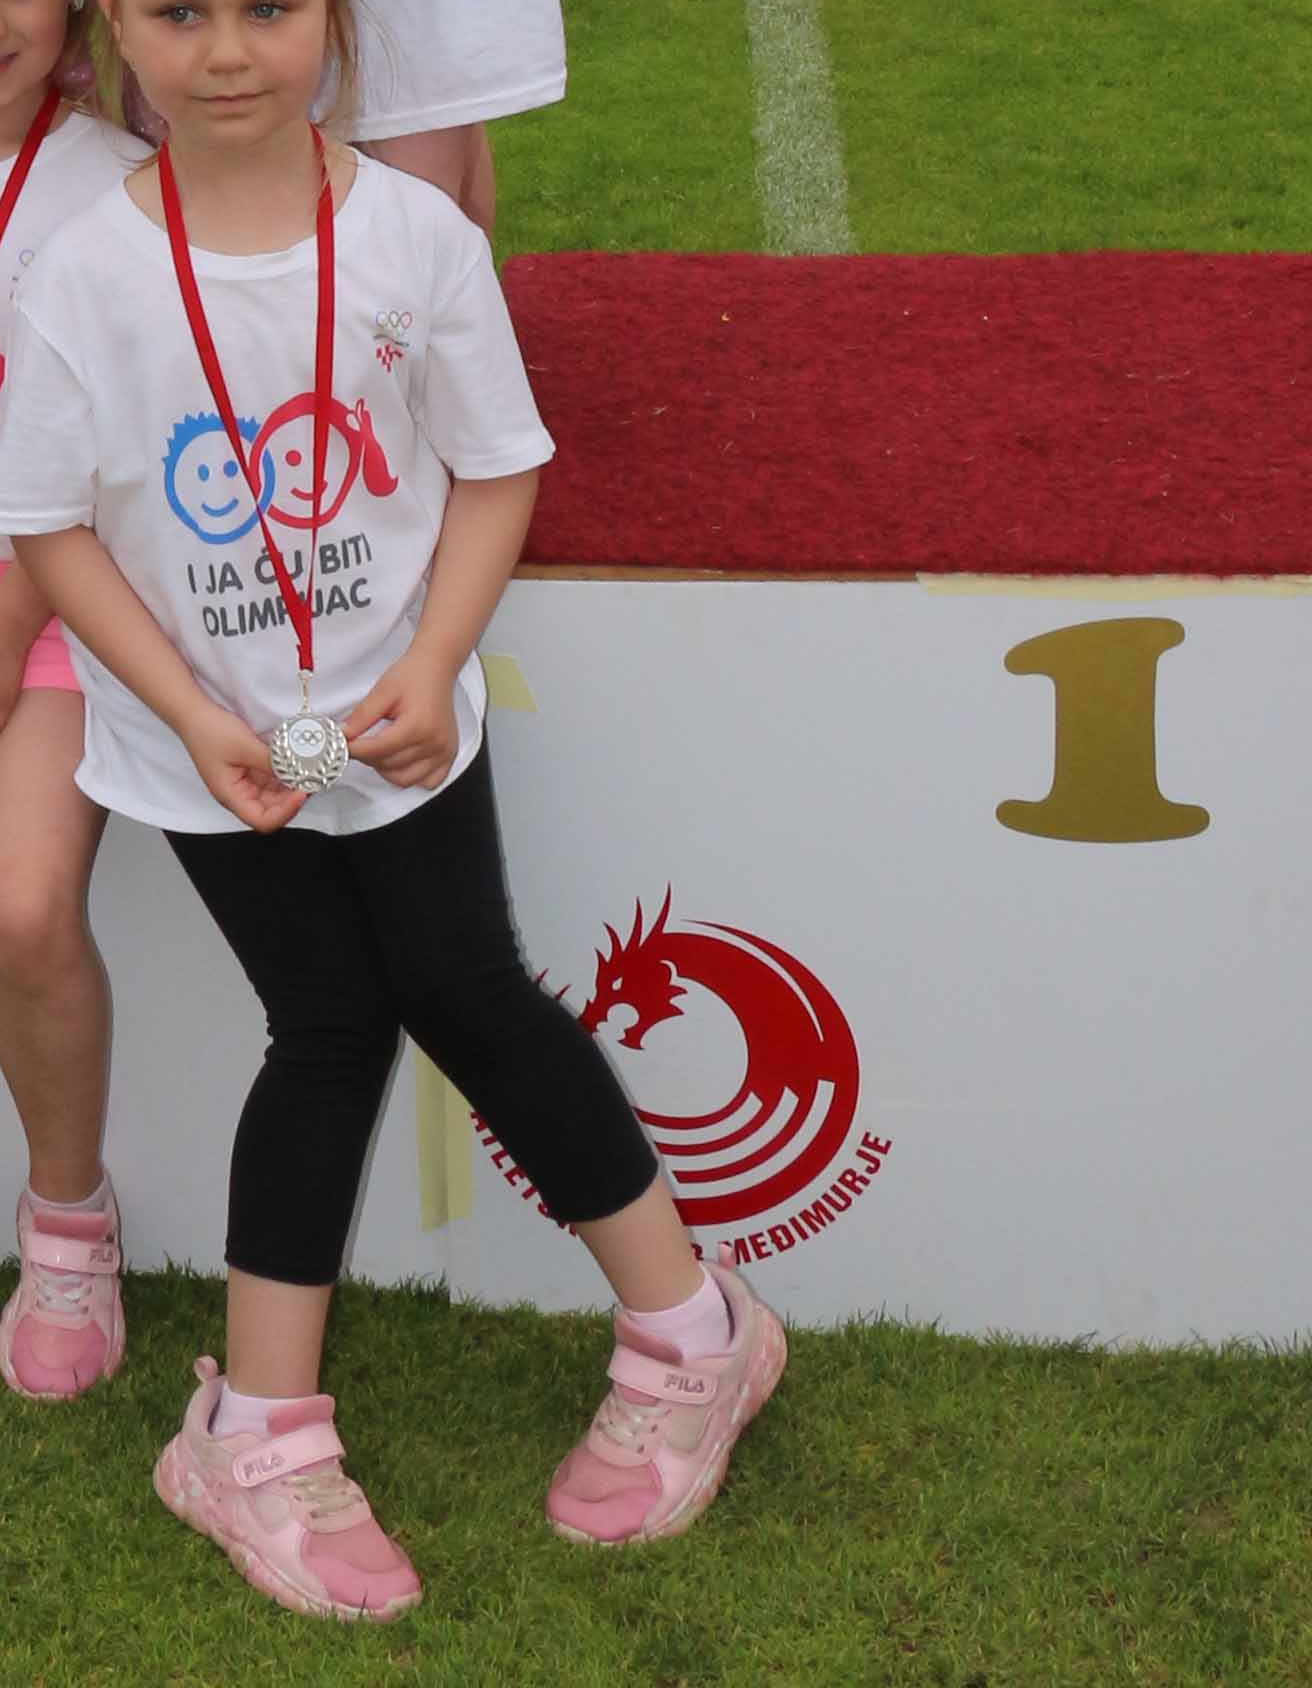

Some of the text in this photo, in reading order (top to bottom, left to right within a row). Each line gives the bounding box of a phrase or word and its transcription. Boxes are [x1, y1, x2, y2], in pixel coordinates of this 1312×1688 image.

[188, 564, 197, 594] I
[205, 561, 244, 595] JA
[319, 532, 373, 575] BITI
[995, 616, 1211, 844] 1
[664, 1372, 705, 1394] FILA
[242, 1453, 285, 1481] FILA
